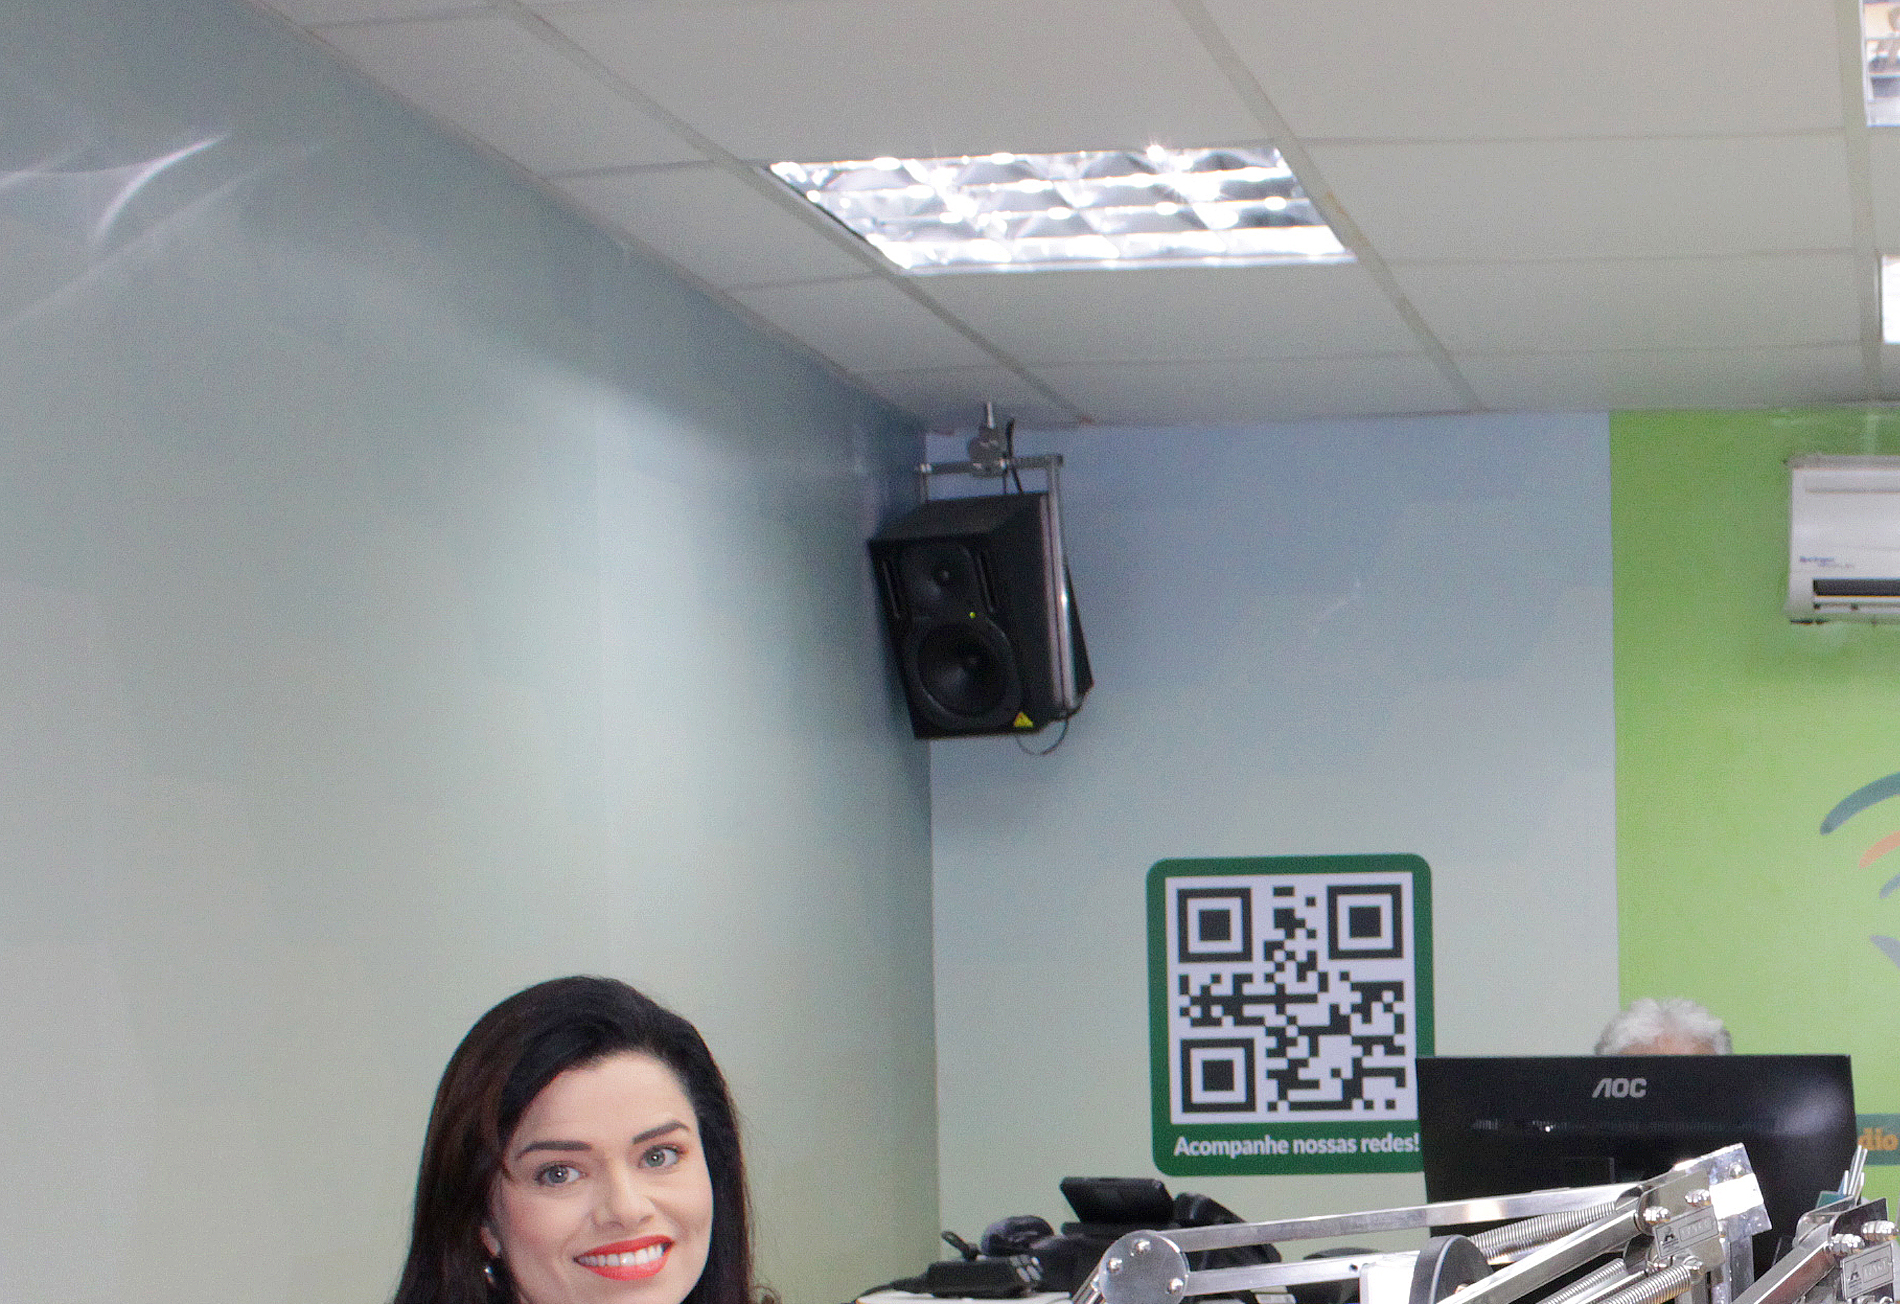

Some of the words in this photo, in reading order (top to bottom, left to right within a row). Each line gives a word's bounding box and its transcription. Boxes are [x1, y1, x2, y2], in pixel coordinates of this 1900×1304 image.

[1592, 1078, 1648, 1098] AOC
[1173, 1135, 1289, 1159] Acompanhe
[1293, 1137, 1357, 1155] nossas
[1360, 1132, 1421, 1153] redes!
[1857, 1128, 1899, 1151] dio
